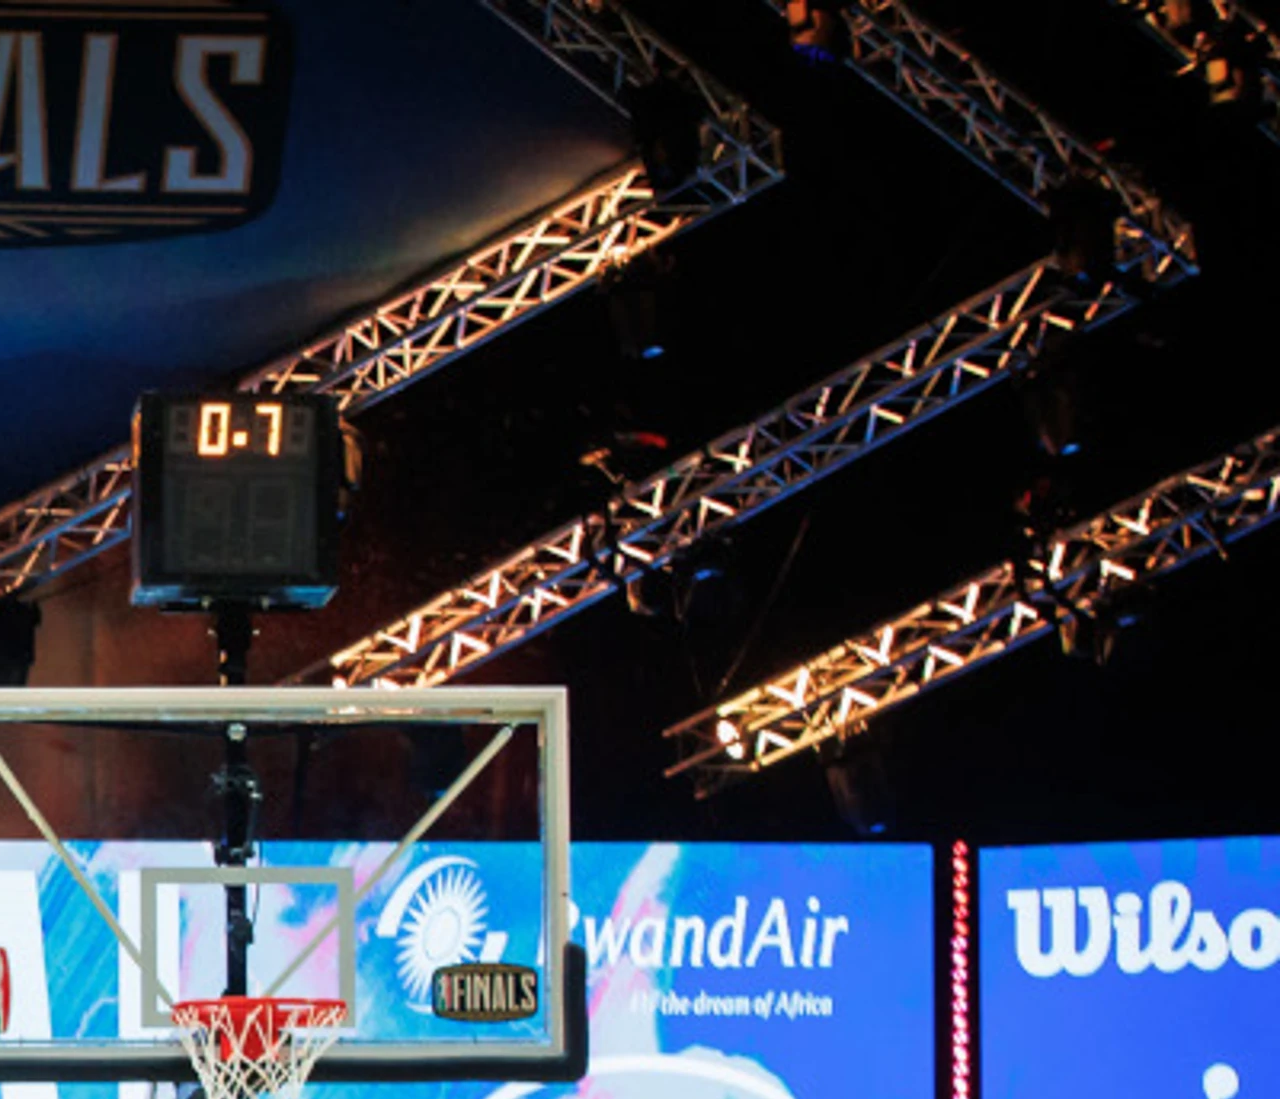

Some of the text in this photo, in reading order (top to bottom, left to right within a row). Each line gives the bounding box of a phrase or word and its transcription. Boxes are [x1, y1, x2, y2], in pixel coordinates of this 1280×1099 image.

[198, 403, 283, 456] 0.7
[1007, 879, 1280, 978] Wilso
[452, 973, 536, 1012] FINALS
